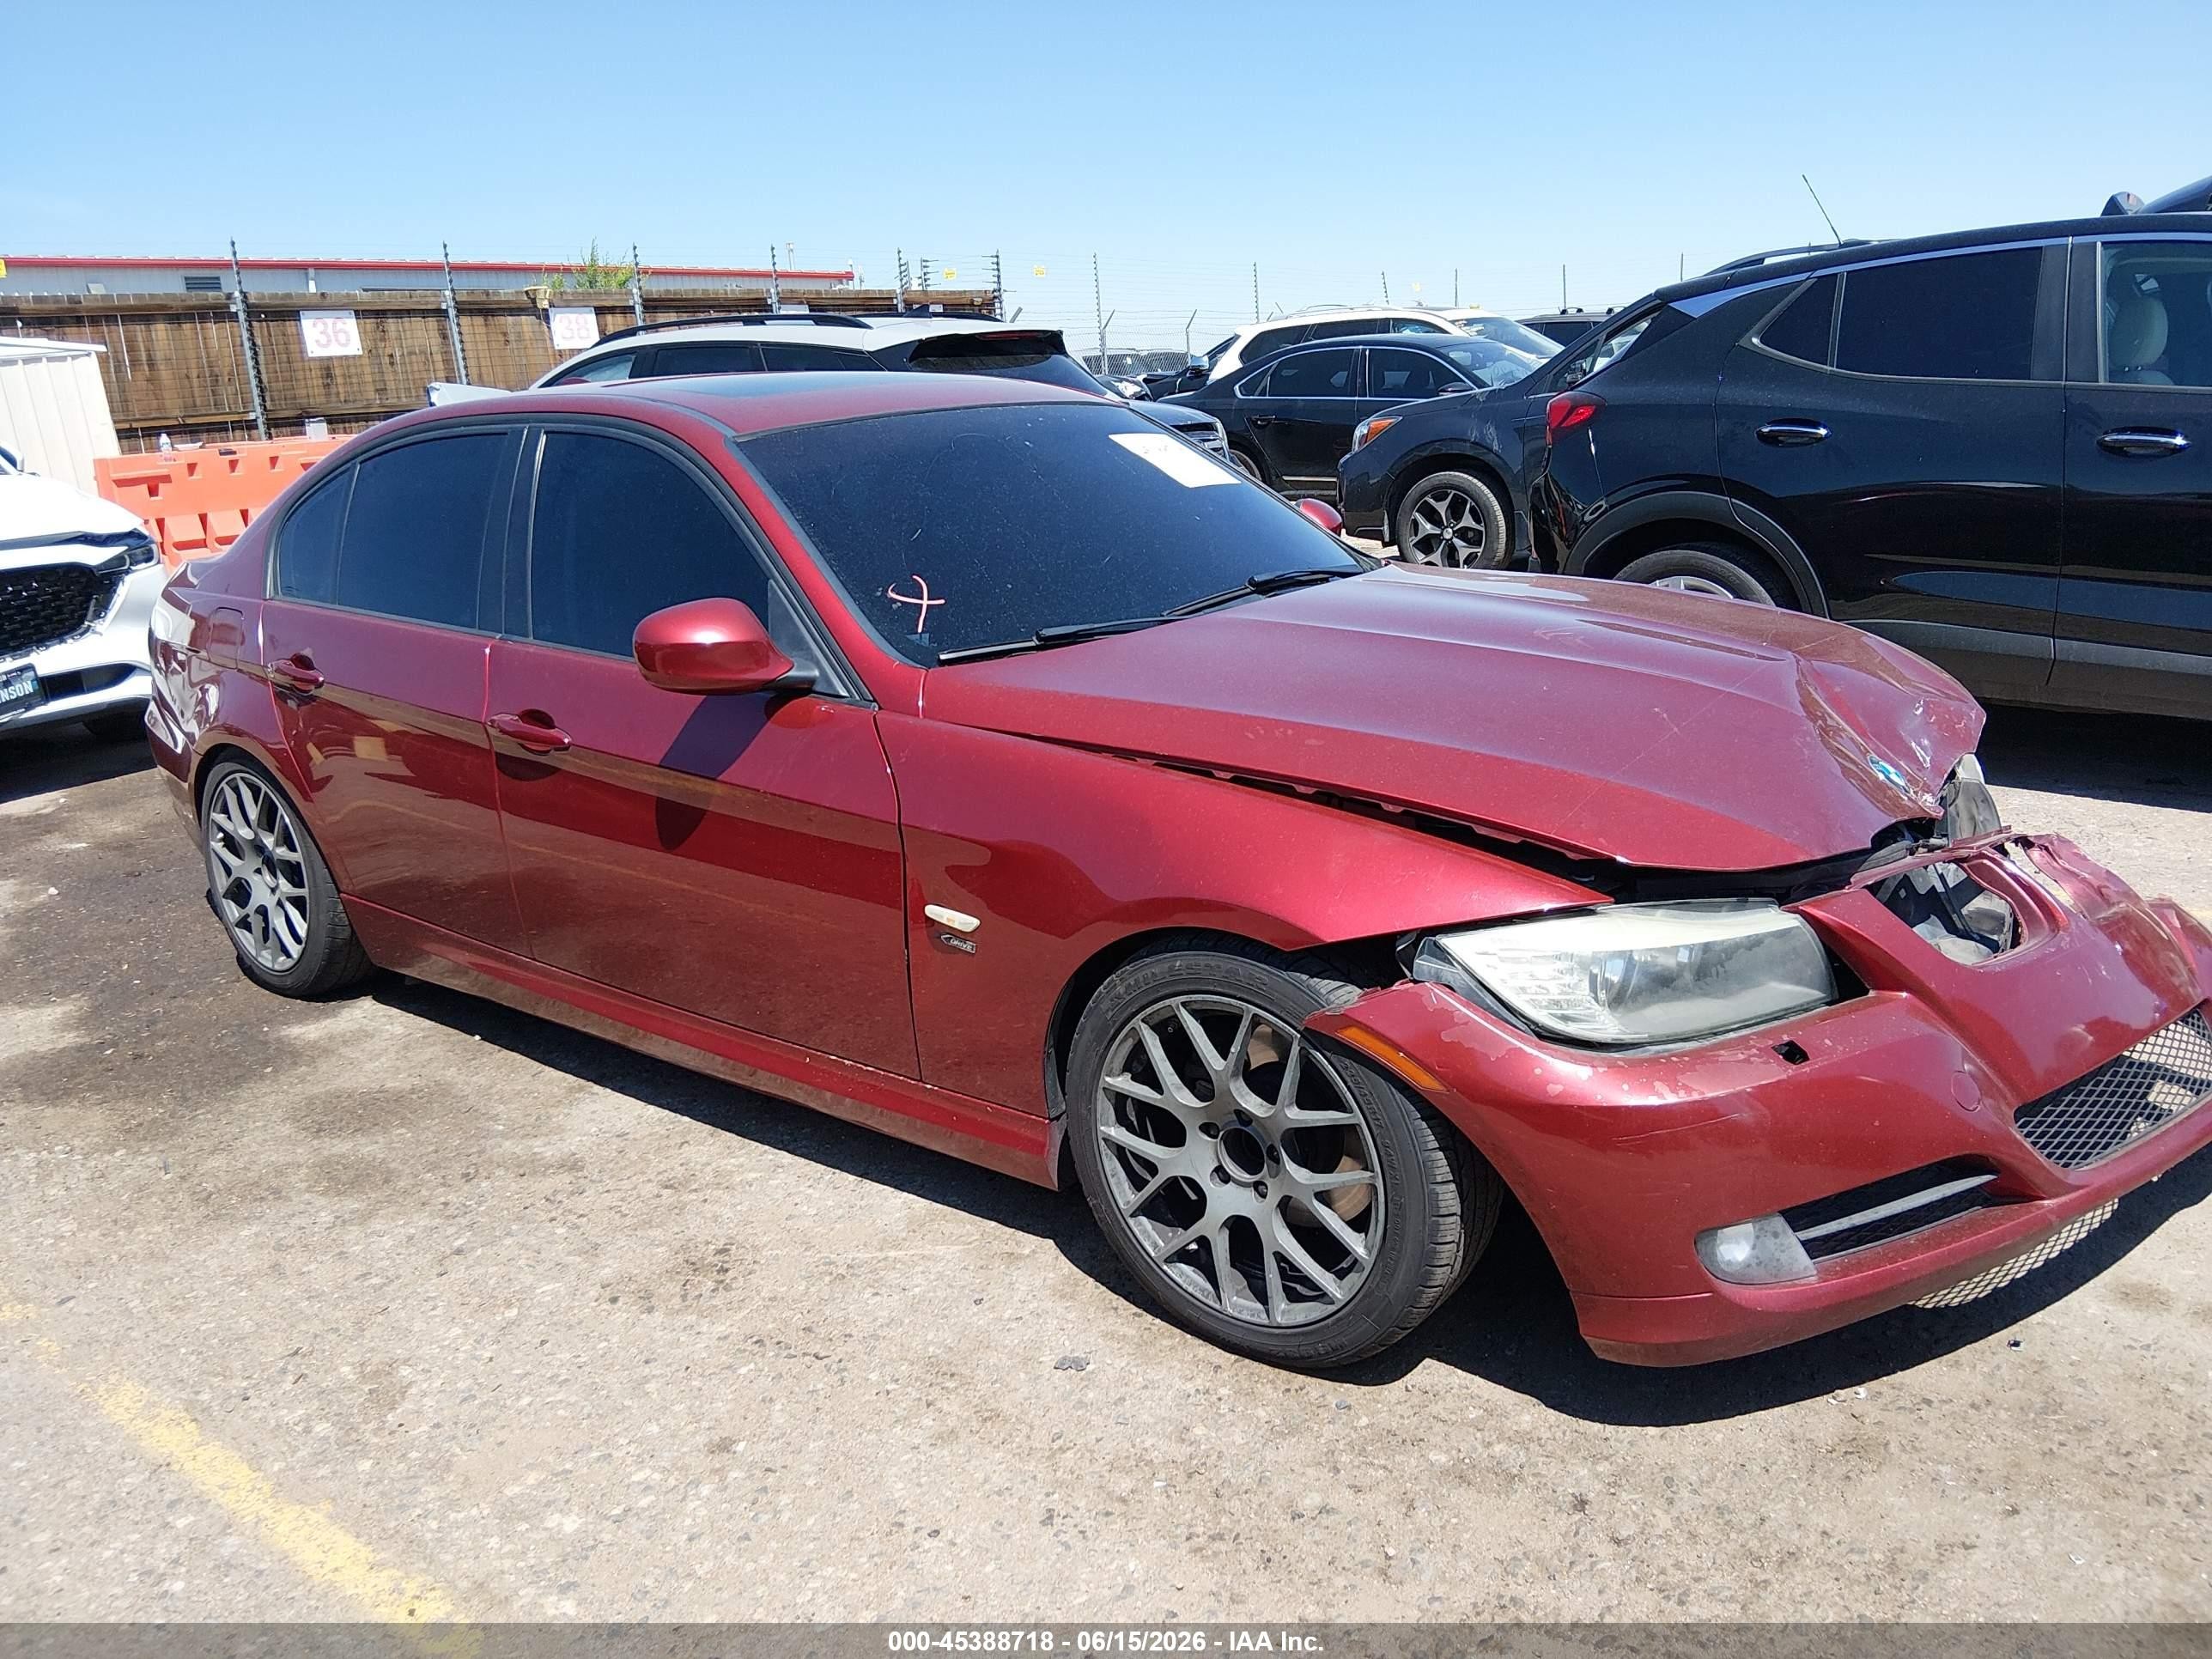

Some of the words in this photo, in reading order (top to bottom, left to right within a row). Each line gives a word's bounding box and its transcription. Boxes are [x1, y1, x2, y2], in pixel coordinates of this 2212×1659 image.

[312, 316, 351, 349] 36
[558, 313, 592, 341] 38
[0, 680, 33, 703] NSON
